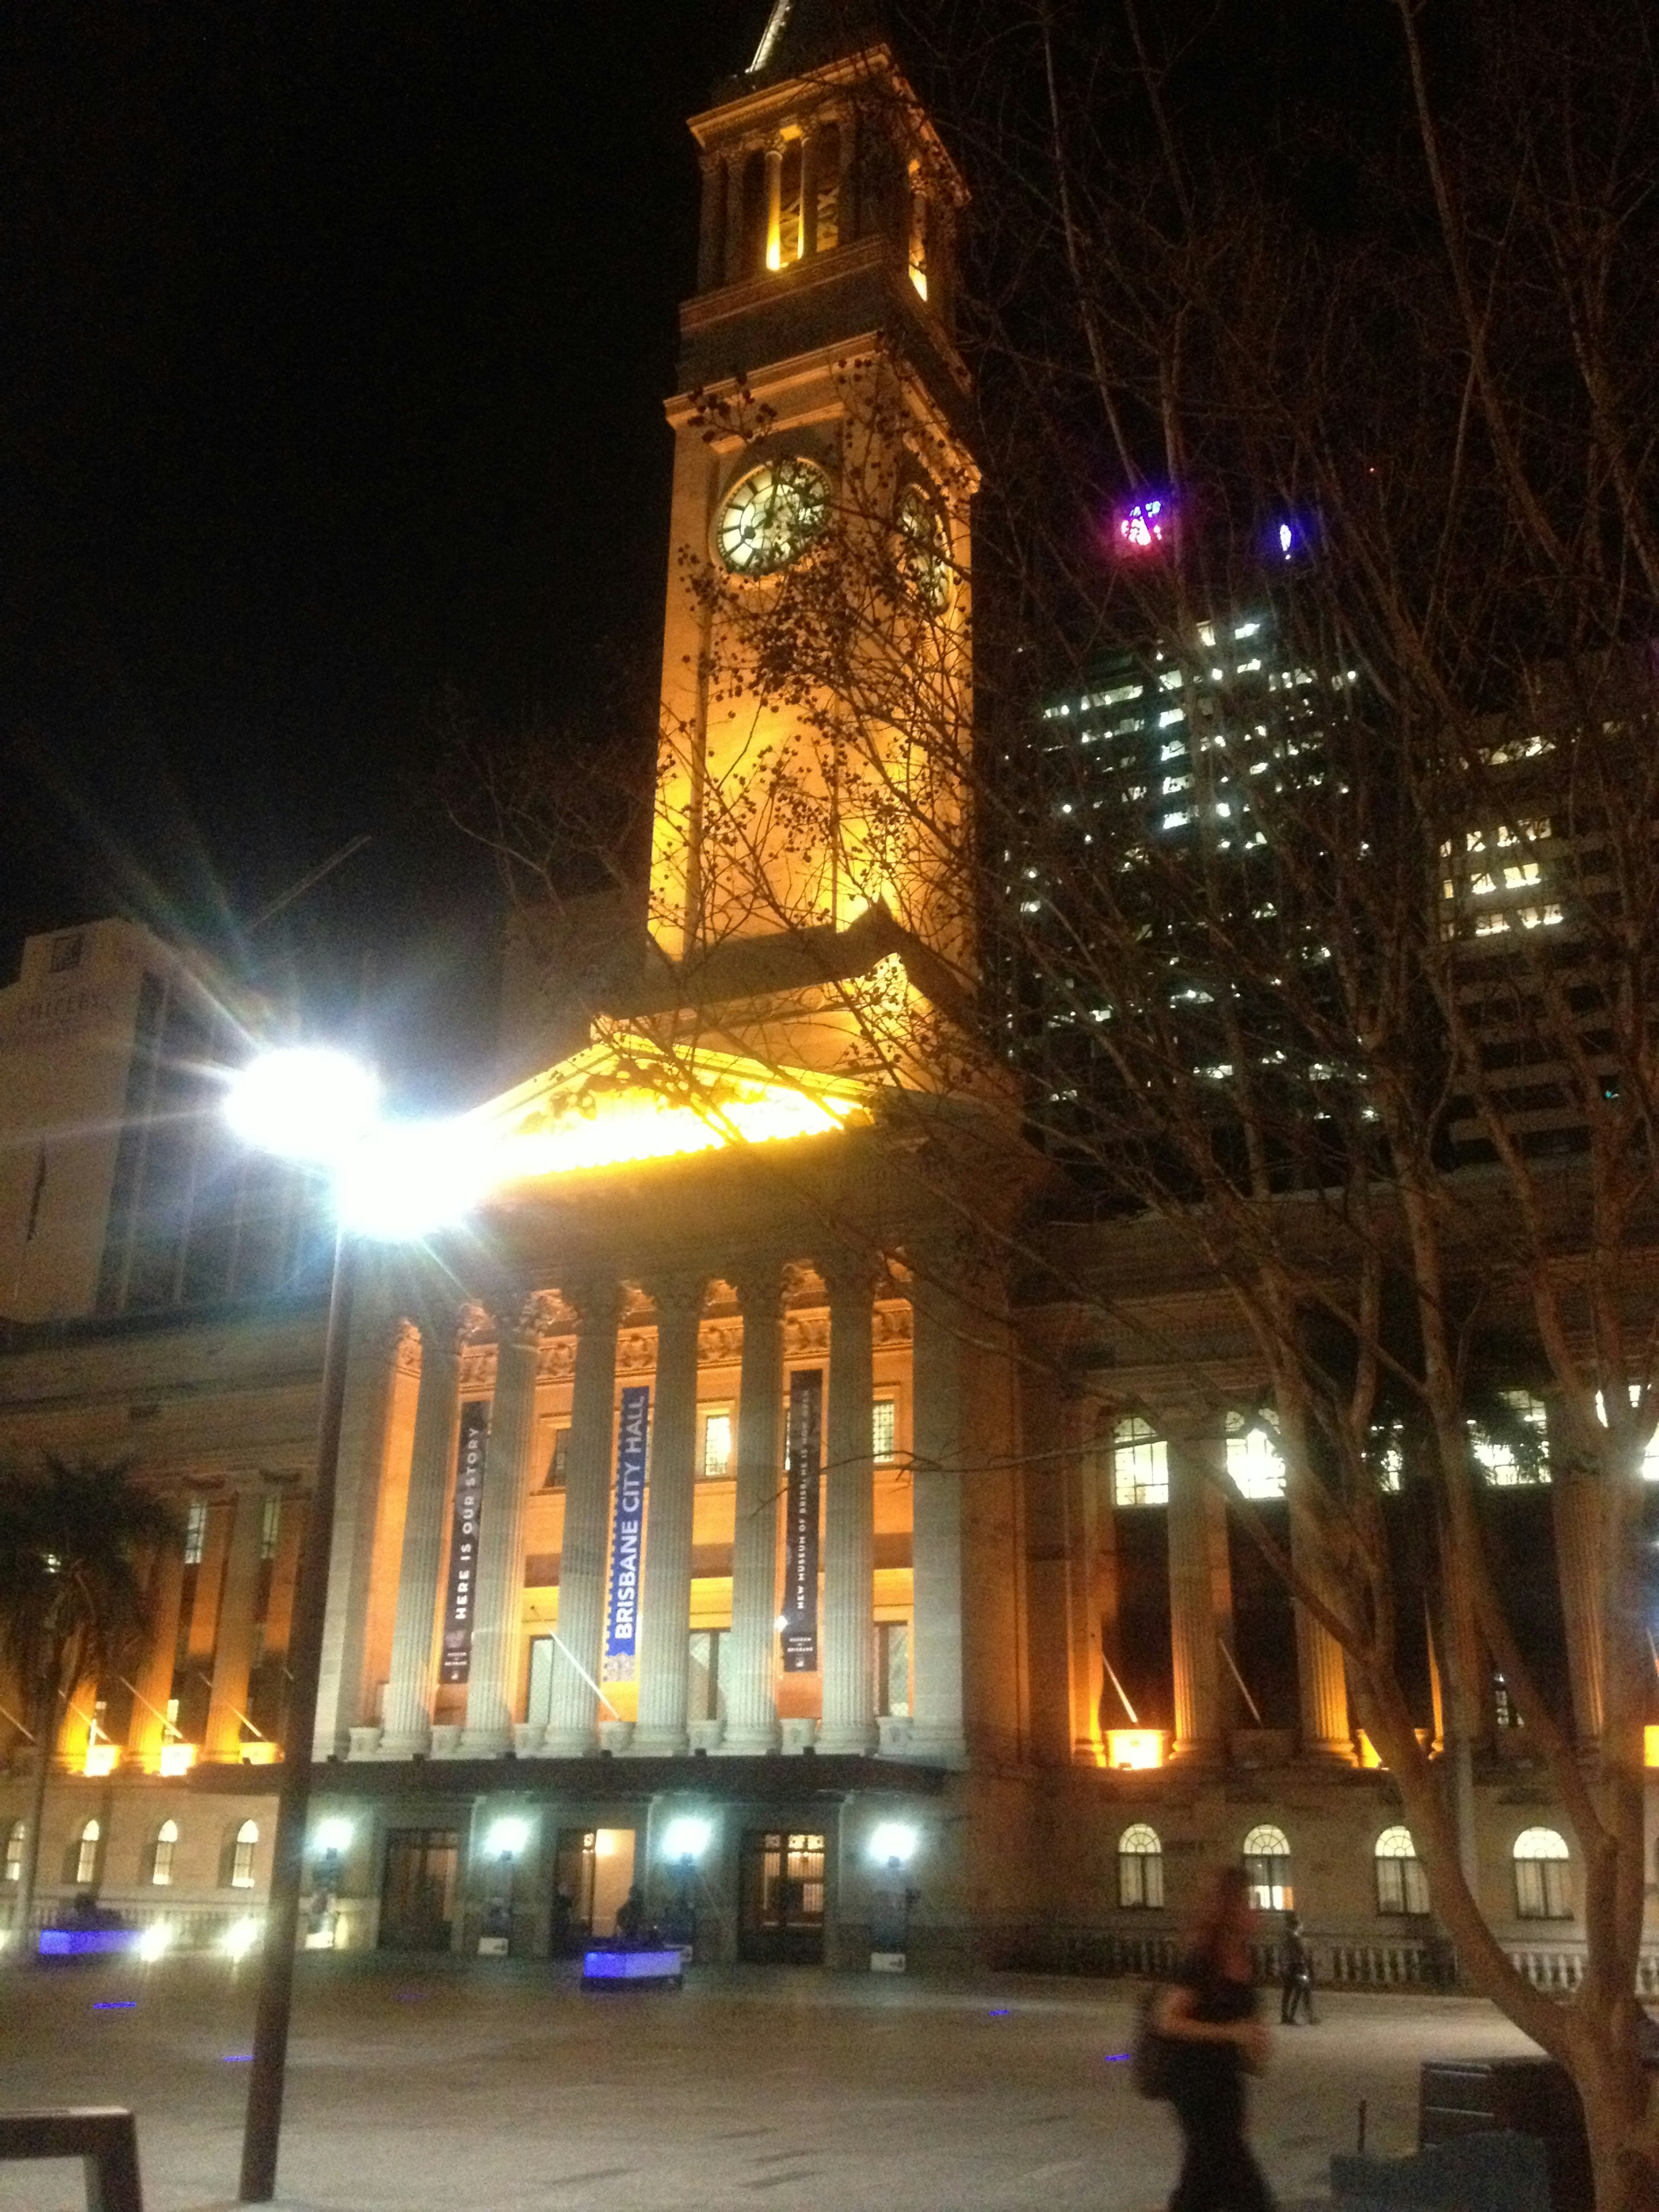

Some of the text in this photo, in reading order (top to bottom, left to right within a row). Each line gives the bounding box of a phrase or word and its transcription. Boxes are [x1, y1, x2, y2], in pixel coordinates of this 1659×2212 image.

[454, 1427, 479, 1620] HERE IS OUR STORY
[614, 1395, 646, 1639] BRISBANE CITY HALL
[797, 1536, 806, 1582] MUSEUM
